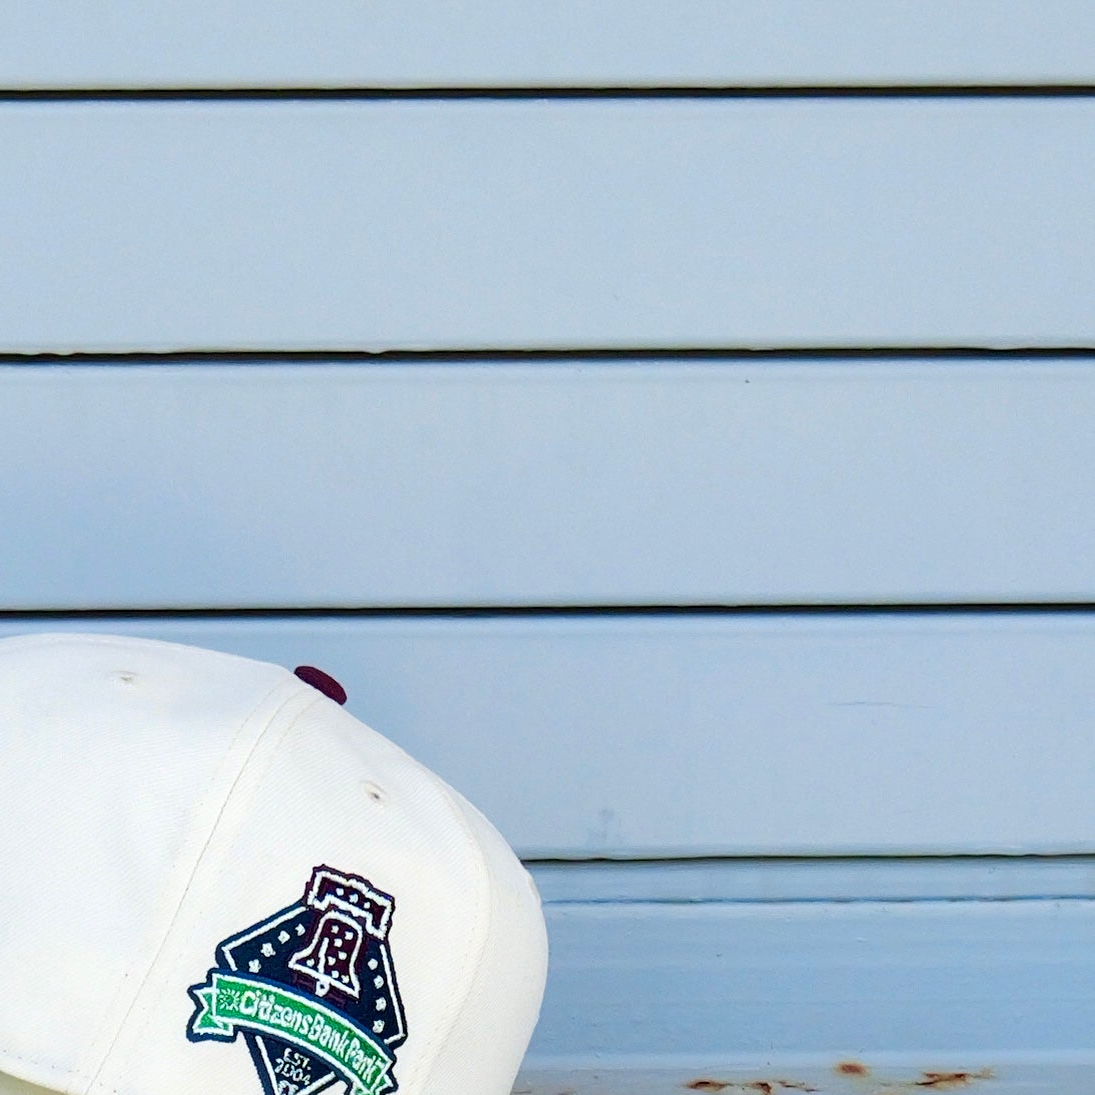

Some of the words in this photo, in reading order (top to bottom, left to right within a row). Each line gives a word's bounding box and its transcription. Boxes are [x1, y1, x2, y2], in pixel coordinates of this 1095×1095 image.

[239, 990, 314, 1035] Citizens
[309, 1013, 349, 1057] Bank
[344, 1038, 378, 1084] Park
